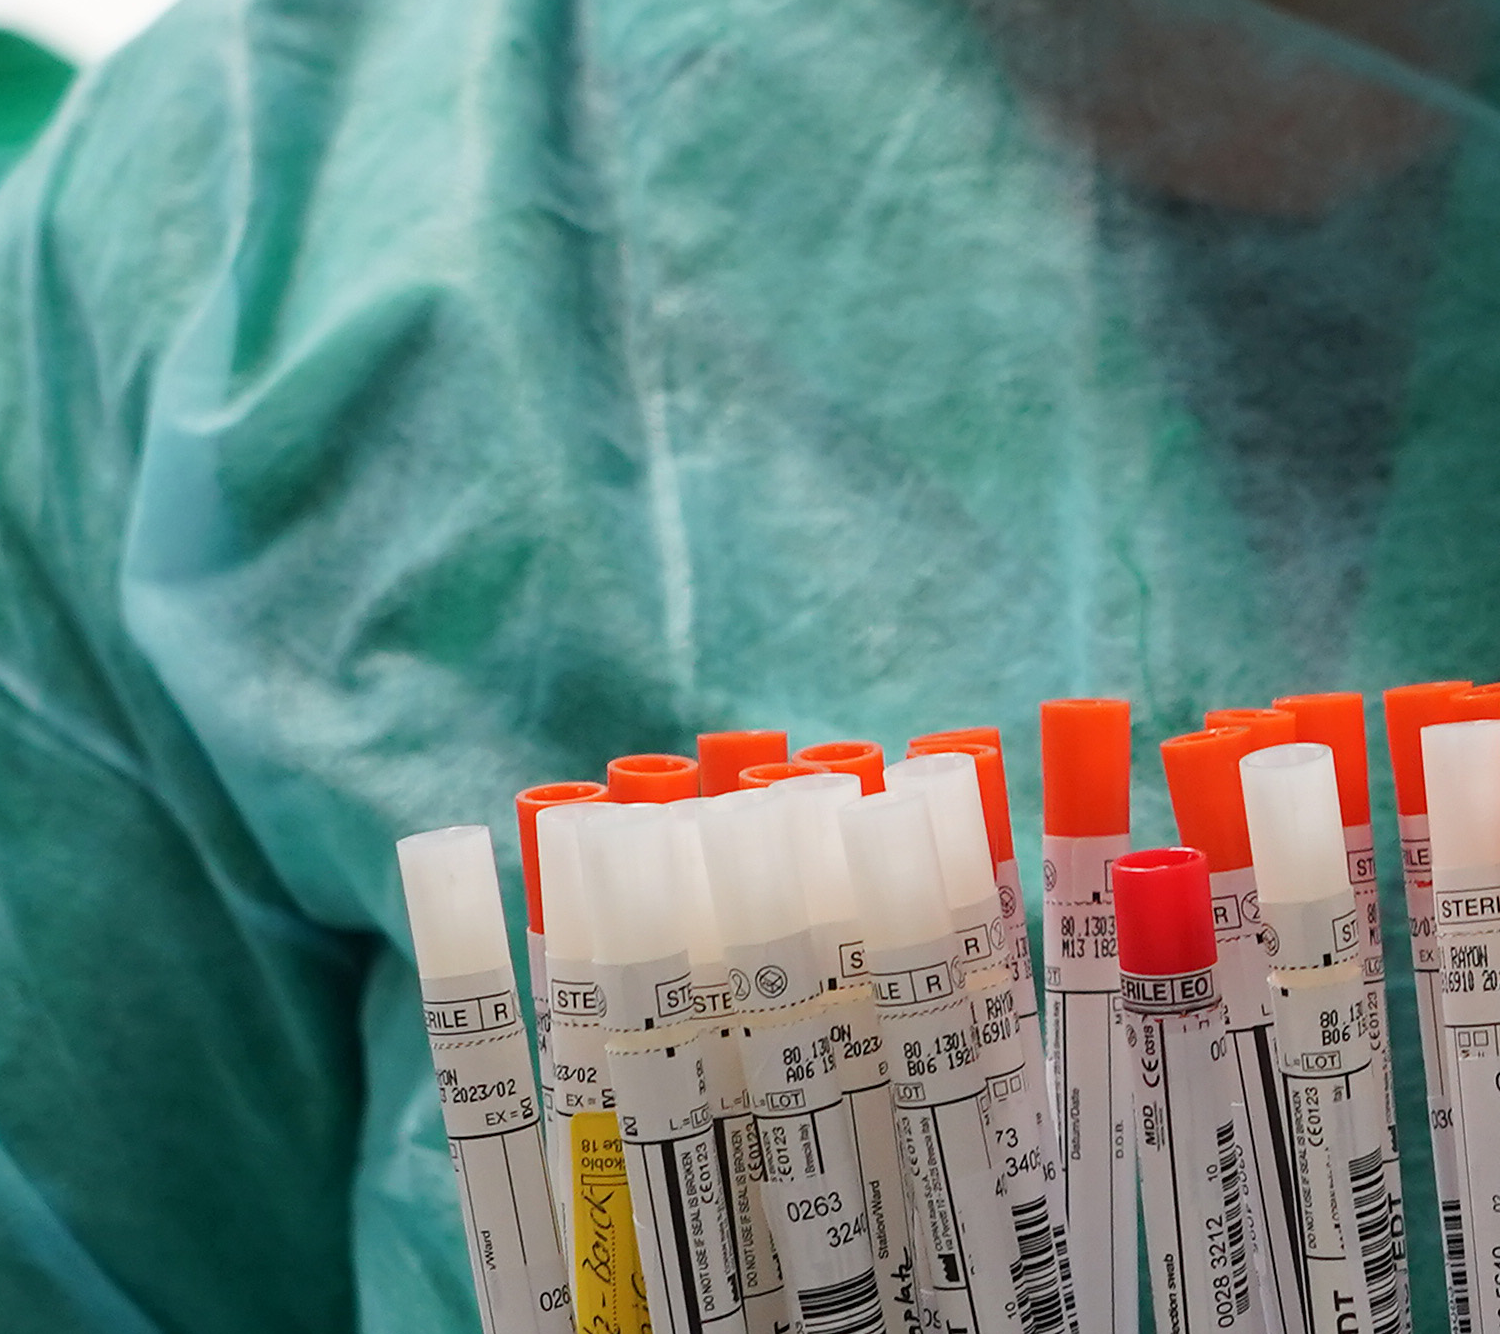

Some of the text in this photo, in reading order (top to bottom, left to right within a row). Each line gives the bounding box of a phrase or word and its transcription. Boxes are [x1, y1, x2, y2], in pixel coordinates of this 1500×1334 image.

[1214, 906, 1229, 925] R
[964, 937, 980, 956] R
[926, 973, 942, 993] R
[1181, 976, 1209, 999] EO
[494, 1002, 509, 1021] R
[1322, 1025, 1351, 1047] B06
[907, 1058, 937, 1077] B06
[1305, 1054, 1337, 1070] LOT
[785, 1063, 815, 1084] A06
[453, 1078, 517, 1105] 2023/02
[769, 1092, 802, 1110] LOT
[787, 1191, 842, 1223] 0263
[1205, 1216, 1235, 1329] 0028 3212
